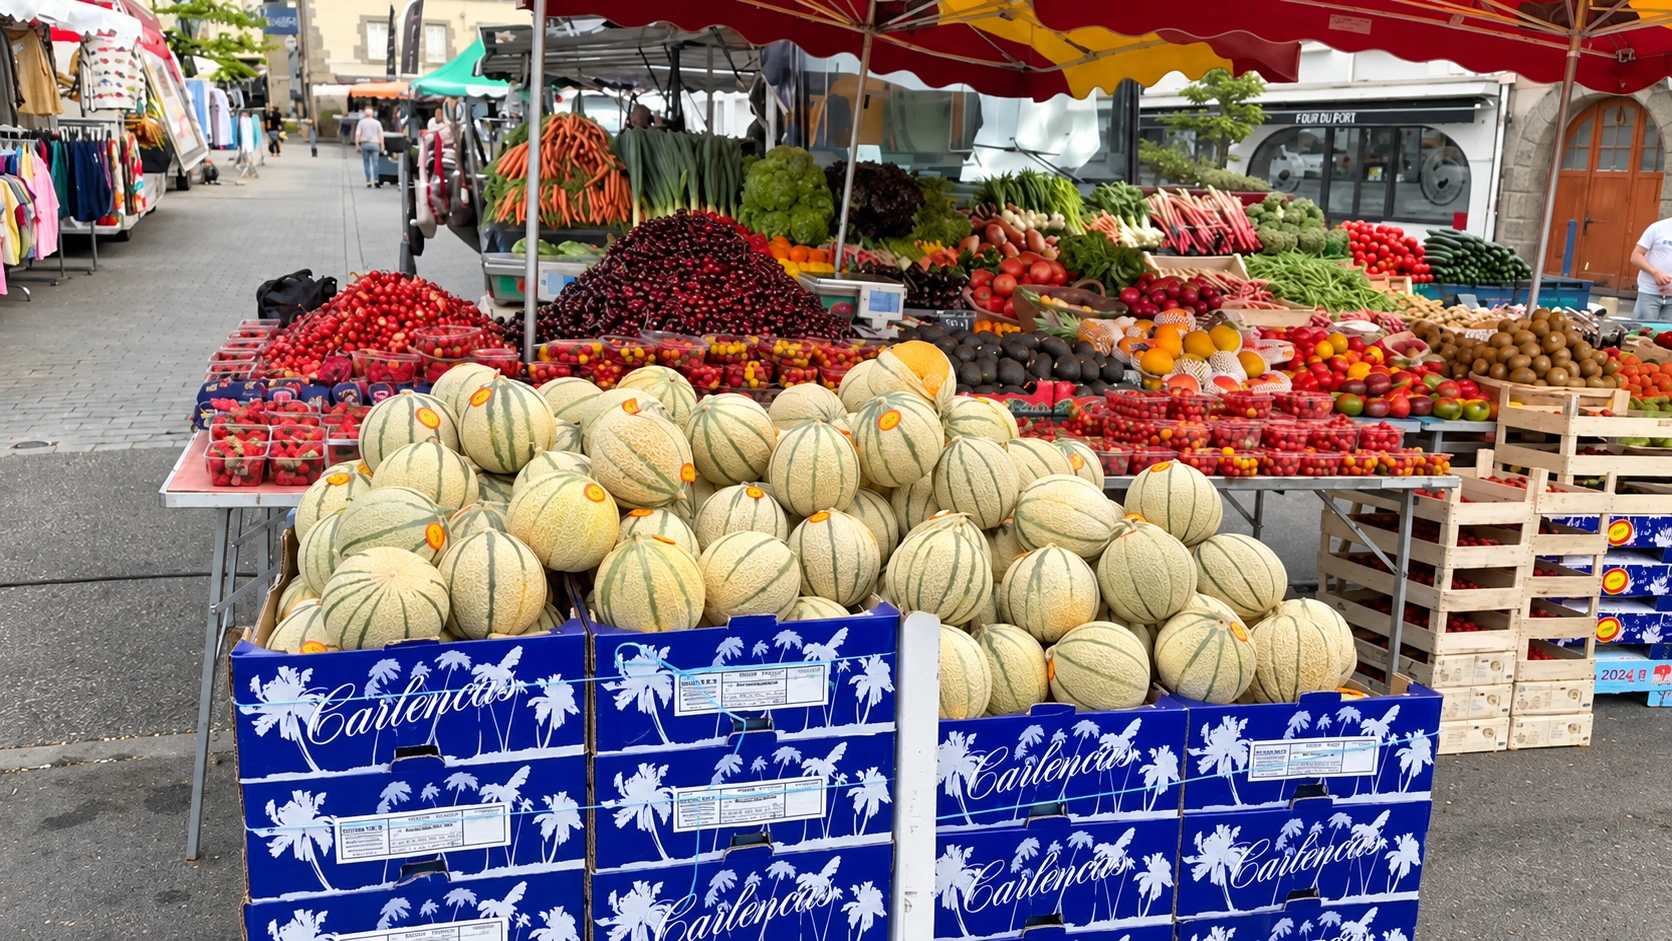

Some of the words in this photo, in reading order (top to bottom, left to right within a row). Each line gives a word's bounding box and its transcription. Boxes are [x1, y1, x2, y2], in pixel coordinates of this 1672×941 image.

[1296, 113, 1319, 124] FOUR
[1320, 113, 1332, 124] DU
[1333, 112, 1356, 124] PORT
[1601, 669, 1634, 683] 2024
[306, 671, 516, 745] Carlencas
[966, 740, 1135, 800] Carlencas
[963, 850, 1129, 913] Carlencas
[1230, 829, 1384, 889] Carlencas
[654, 878, 834, 941] Carlencas
